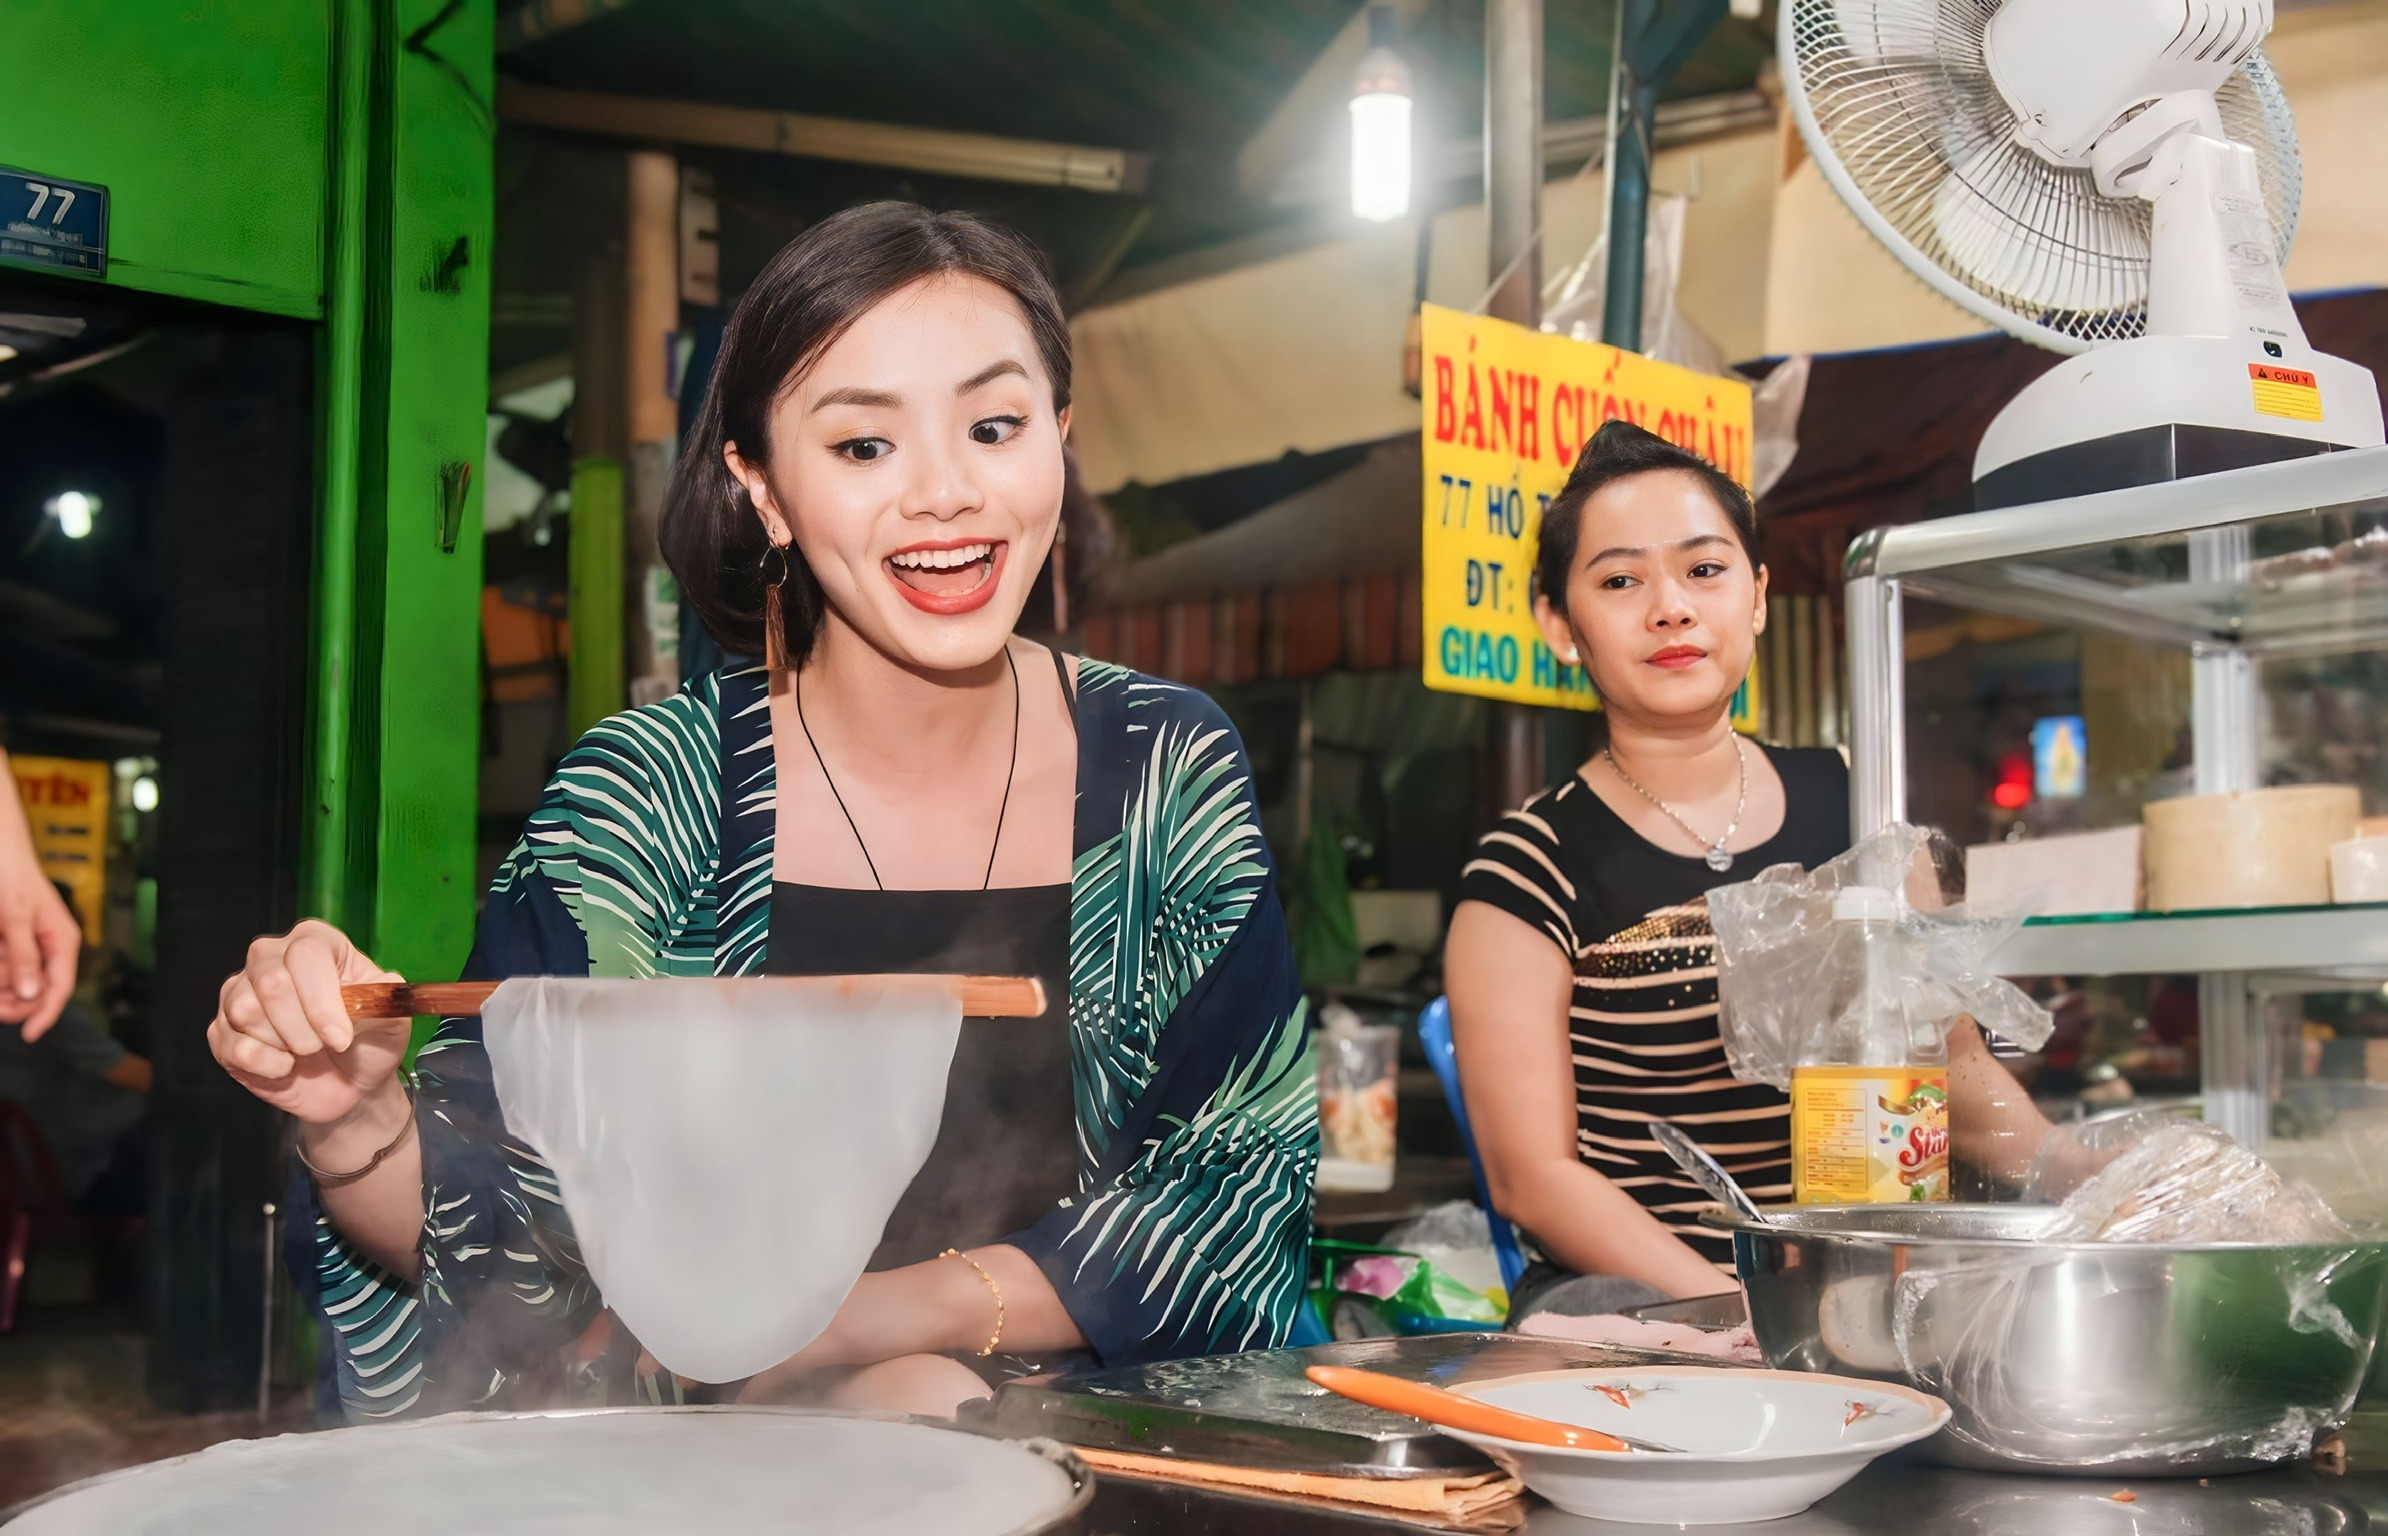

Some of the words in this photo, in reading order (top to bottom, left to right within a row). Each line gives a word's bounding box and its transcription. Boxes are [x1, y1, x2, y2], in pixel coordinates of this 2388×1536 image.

[25, 182, 75, 225] 77
[1434, 334, 1540, 461] BÁNH
[1441, 475, 1471, 529] 77
[1467, 559, 1514, 614] ĐT:
[1441, 625, 1519, 685] GIAO
